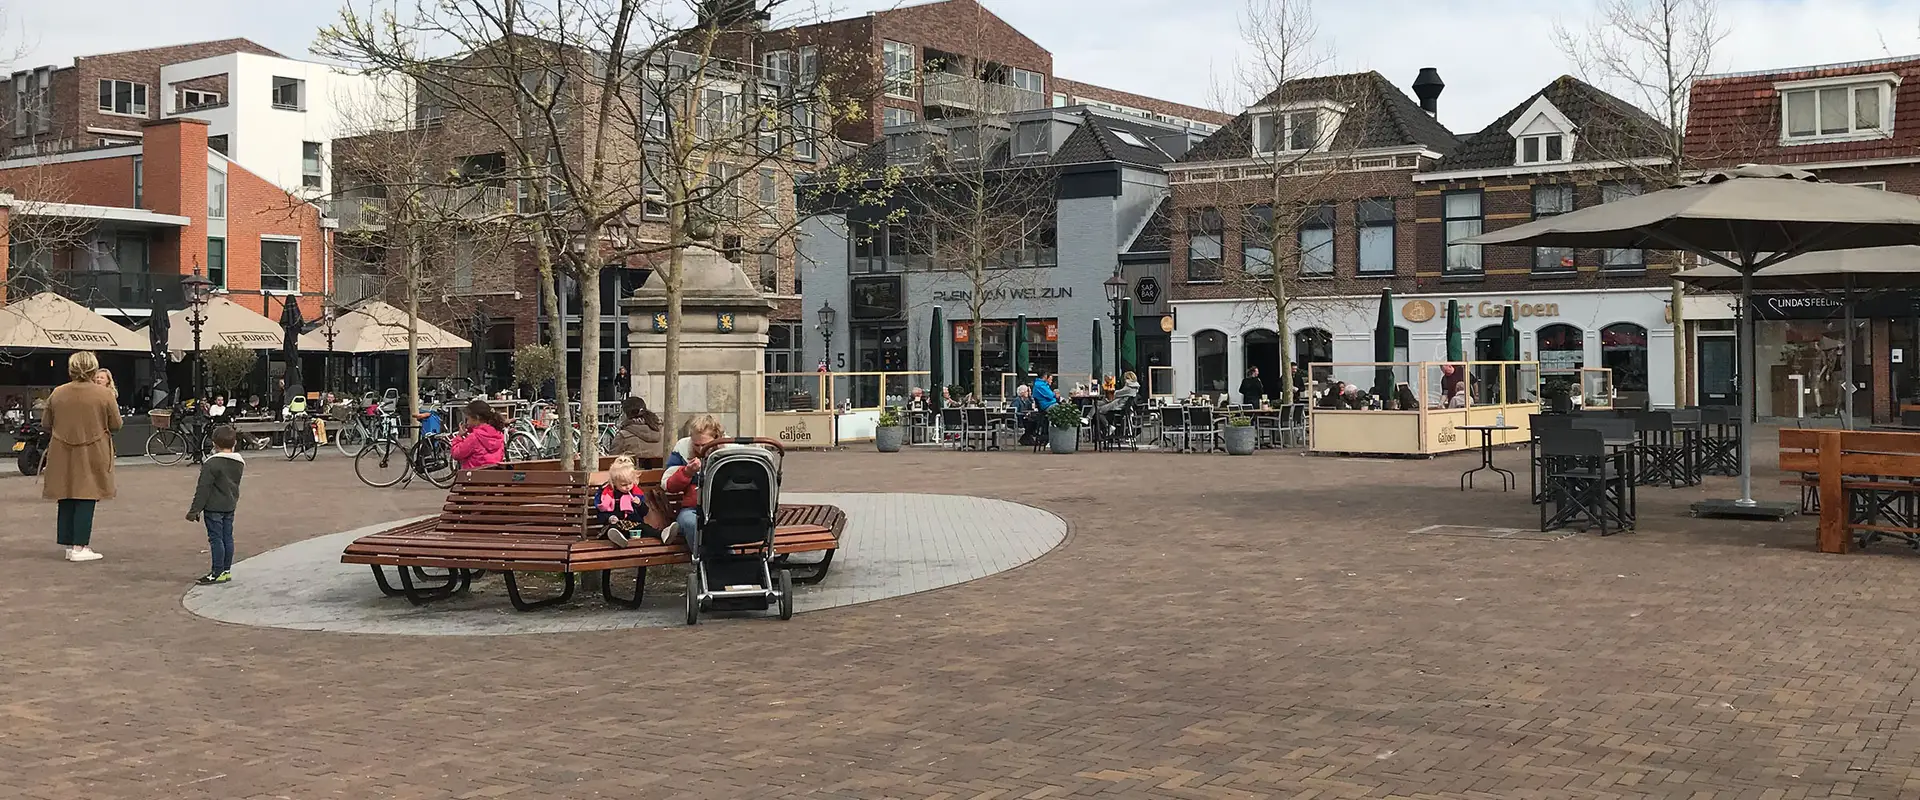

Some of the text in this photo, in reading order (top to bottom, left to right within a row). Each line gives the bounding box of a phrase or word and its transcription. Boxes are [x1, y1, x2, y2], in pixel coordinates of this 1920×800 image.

[933, 290, 972, 301] PLEIN
[1478, 299, 1560, 322] Gajoen
[69, 333, 110, 342] BUREN
[226, 333, 276, 342] DE BUREN
[402, 335, 432, 343] BREN
[837, 352, 846, 369] 5
[780, 430, 812, 442] Galjoen
